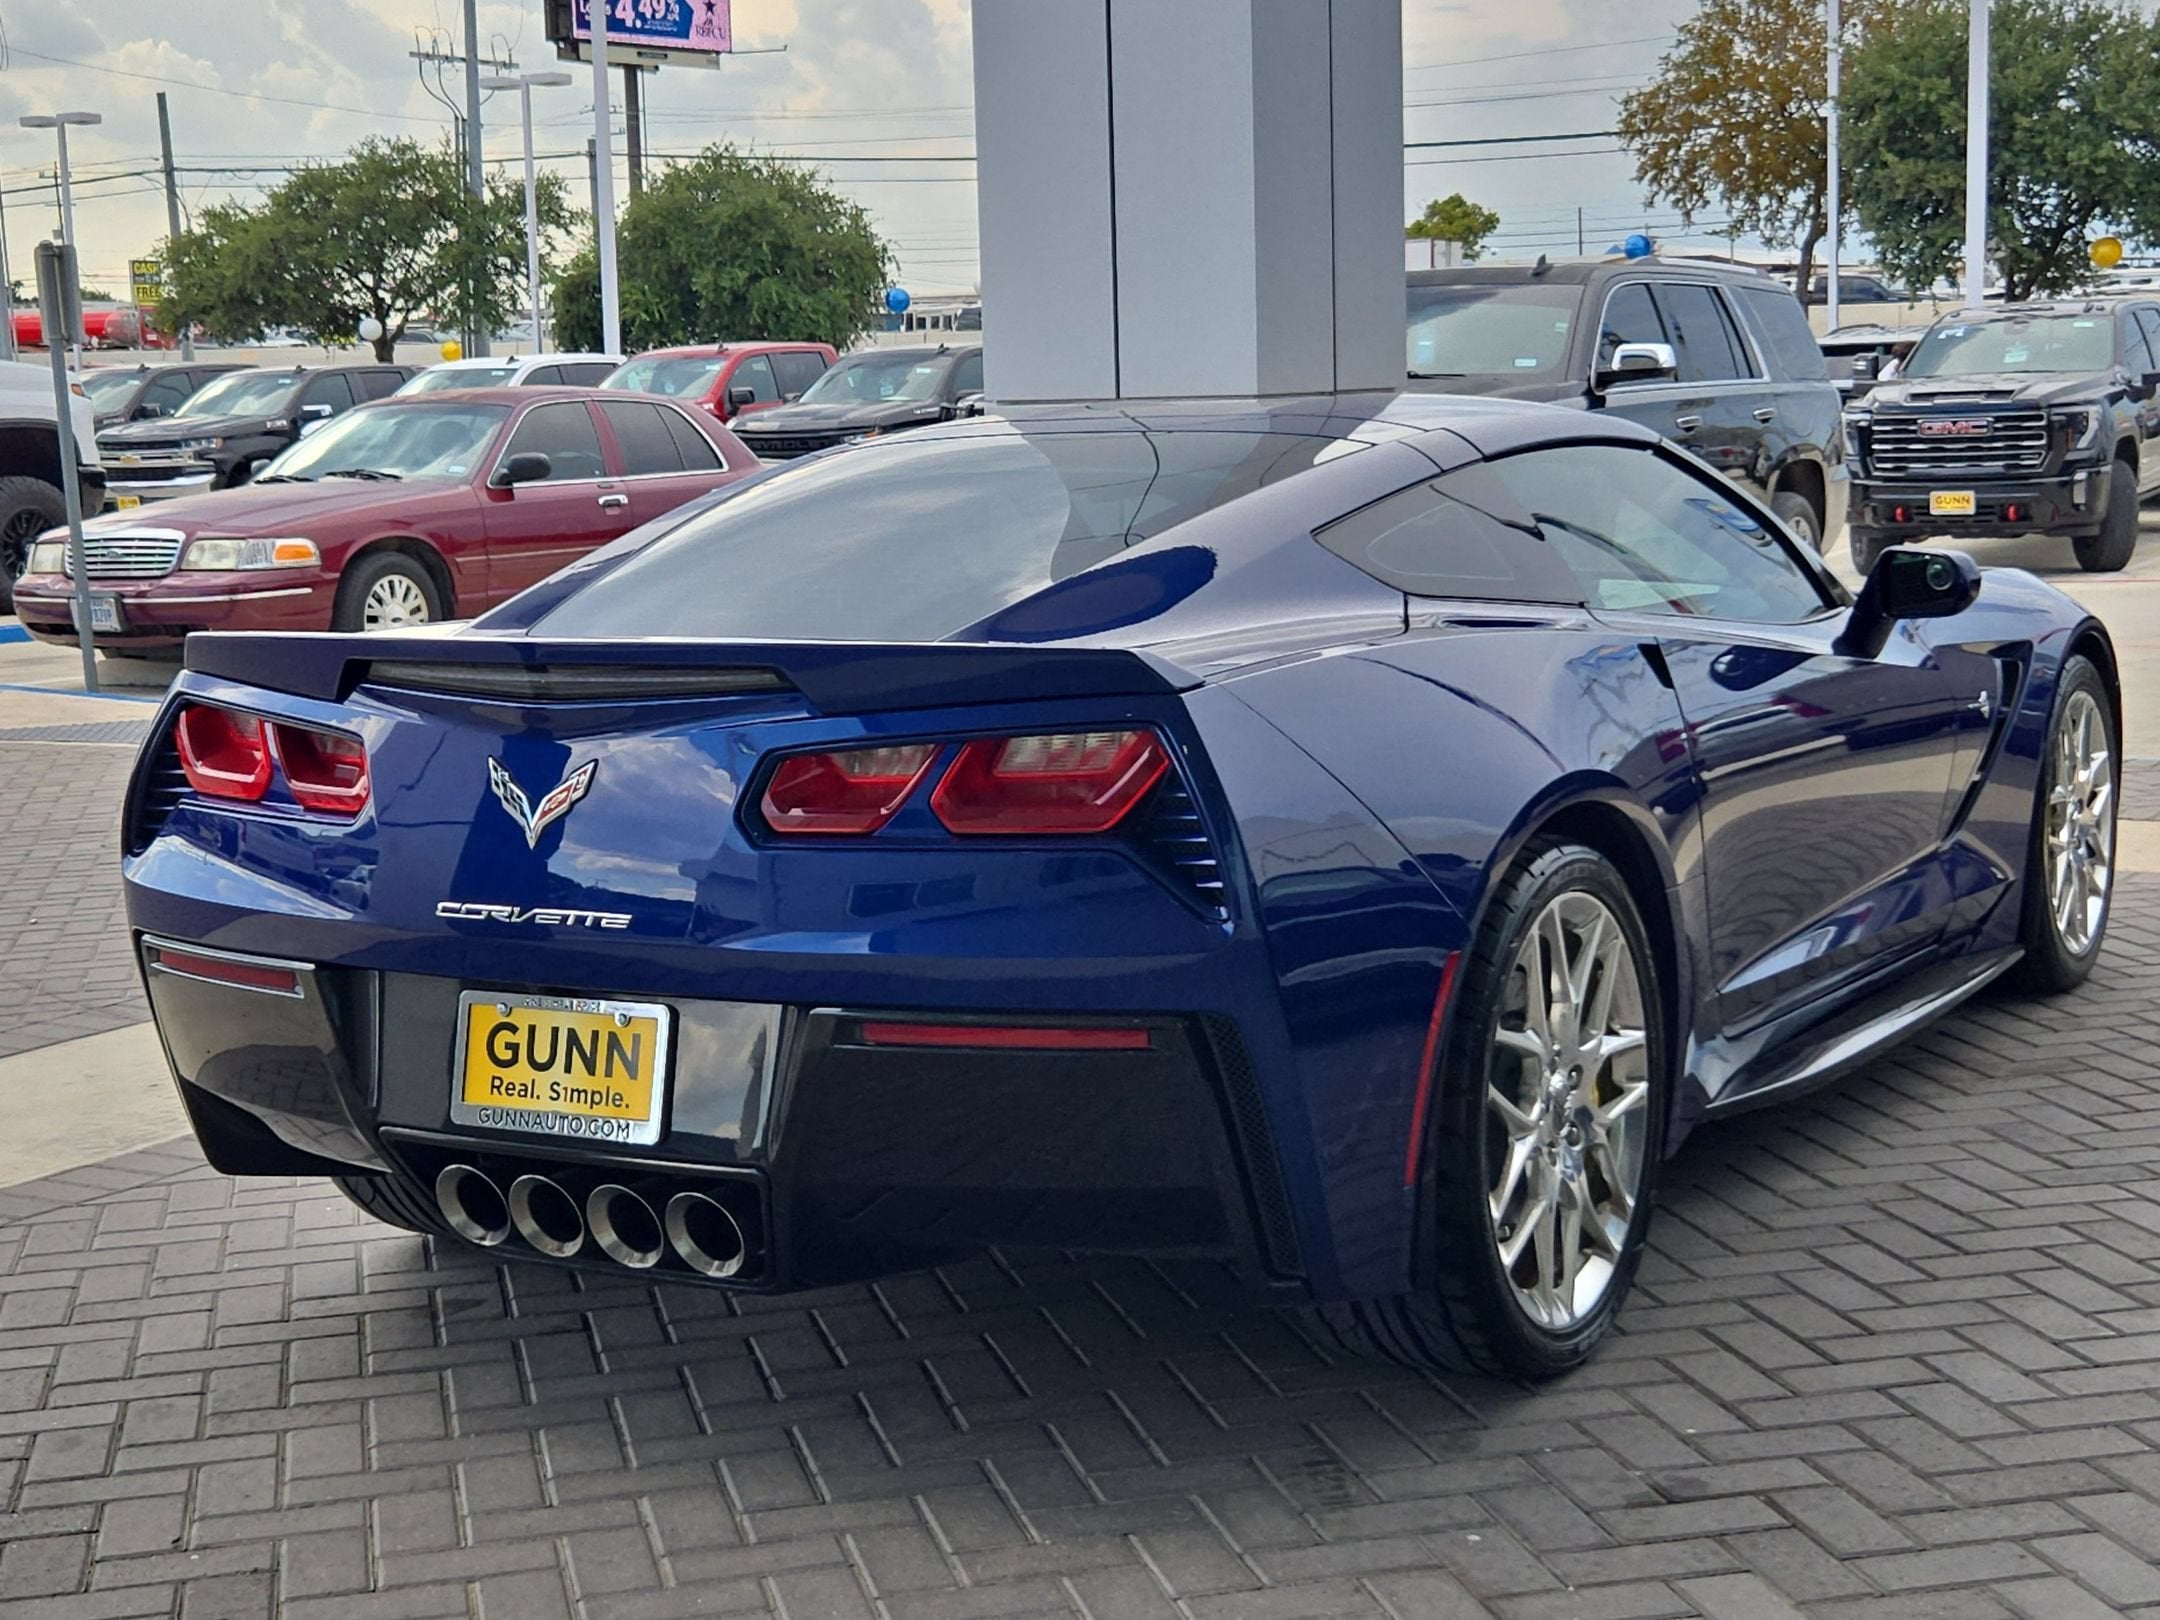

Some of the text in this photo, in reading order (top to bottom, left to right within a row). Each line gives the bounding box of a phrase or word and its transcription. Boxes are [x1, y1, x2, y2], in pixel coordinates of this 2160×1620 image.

[1920, 421, 1988, 435] GMC
[1935, 496, 1971, 505] GUNN
[435, 902, 633, 928] CORVETTE
[485, 1021, 641, 1081] GUNN
[490, 1075, 540, 1100] Real.
[478, 1107, 631, 1141] GUNNAUTO.COM
